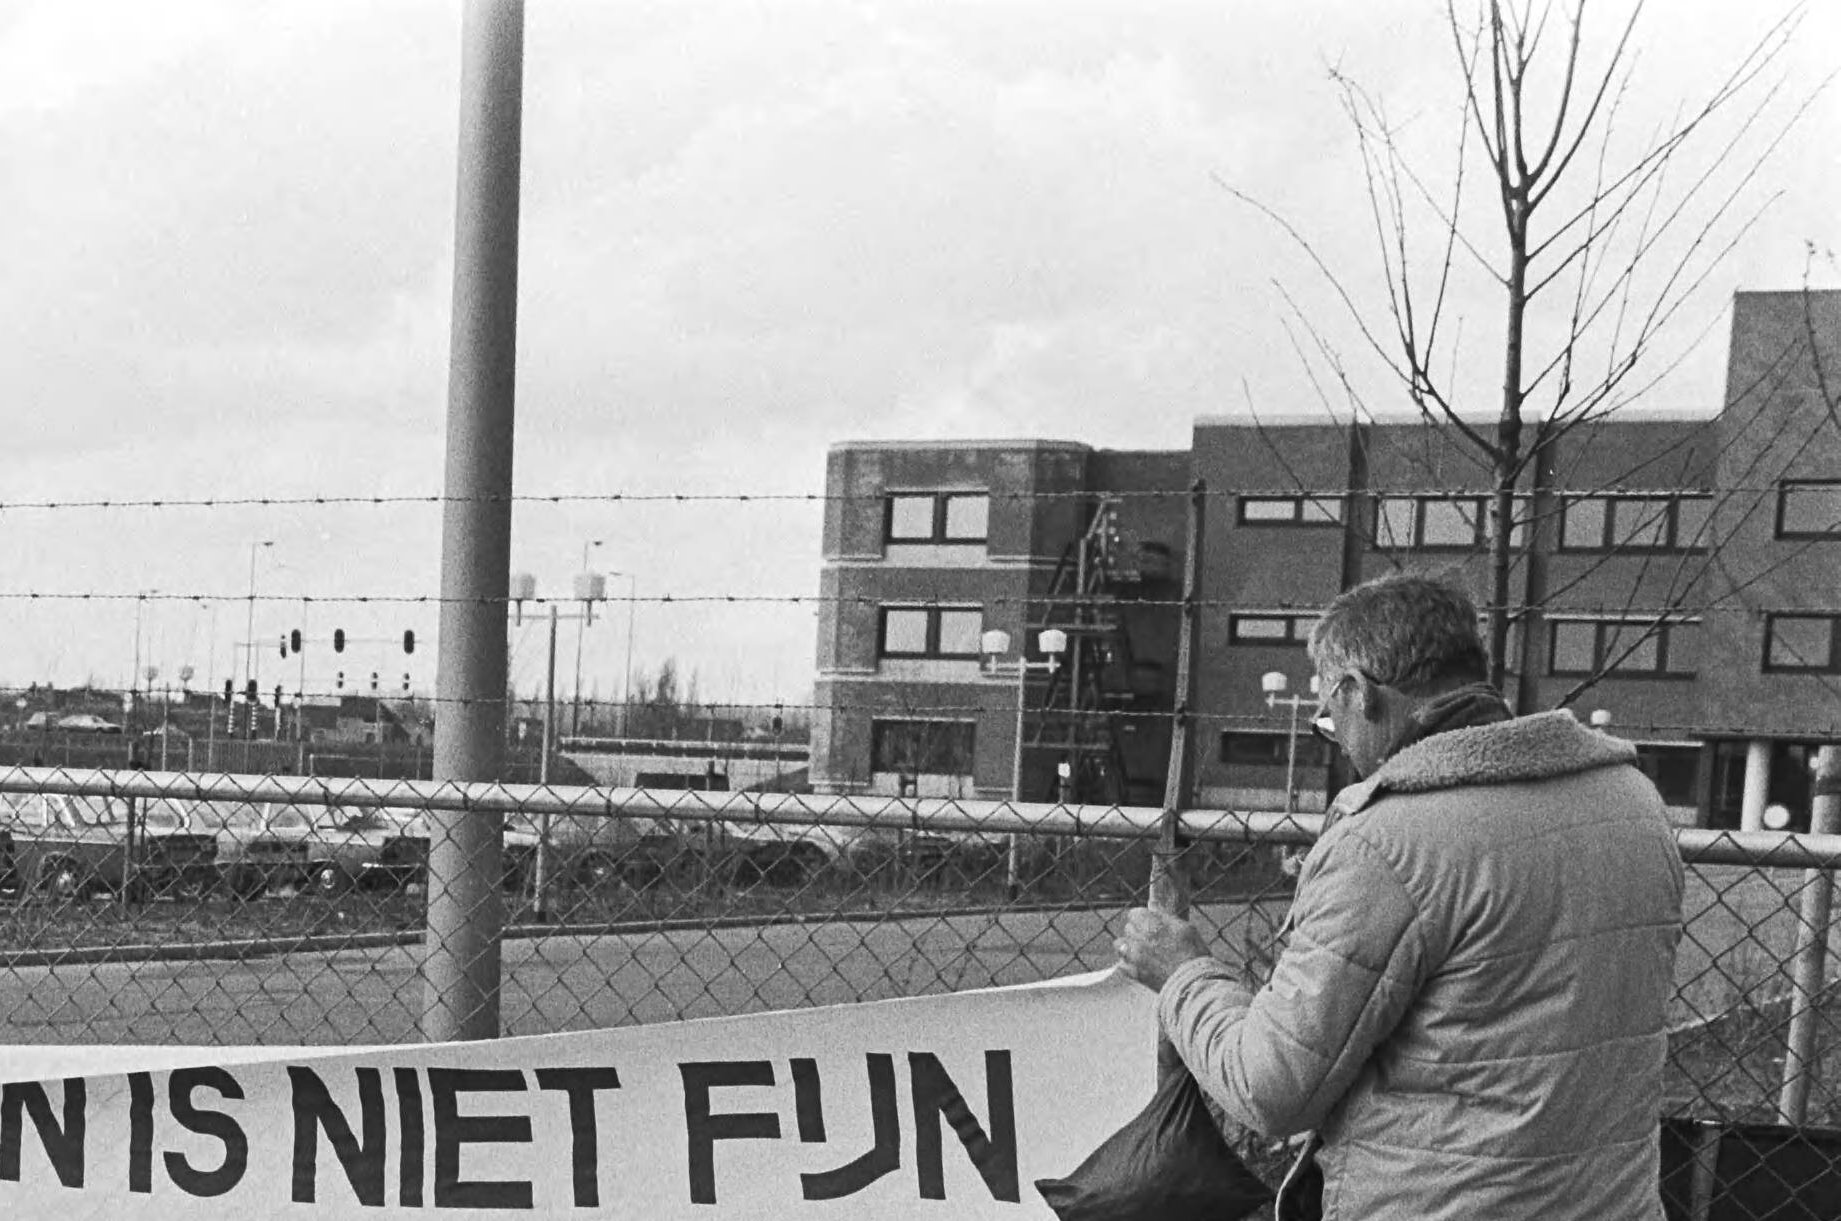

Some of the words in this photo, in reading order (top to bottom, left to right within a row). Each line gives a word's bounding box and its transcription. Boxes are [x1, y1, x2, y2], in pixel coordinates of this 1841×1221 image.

[127, 1065, 248, 1197] IS
[286, 1066, 621, 1208] NIET
[678, 1049, 1021, 1204] FIJN
